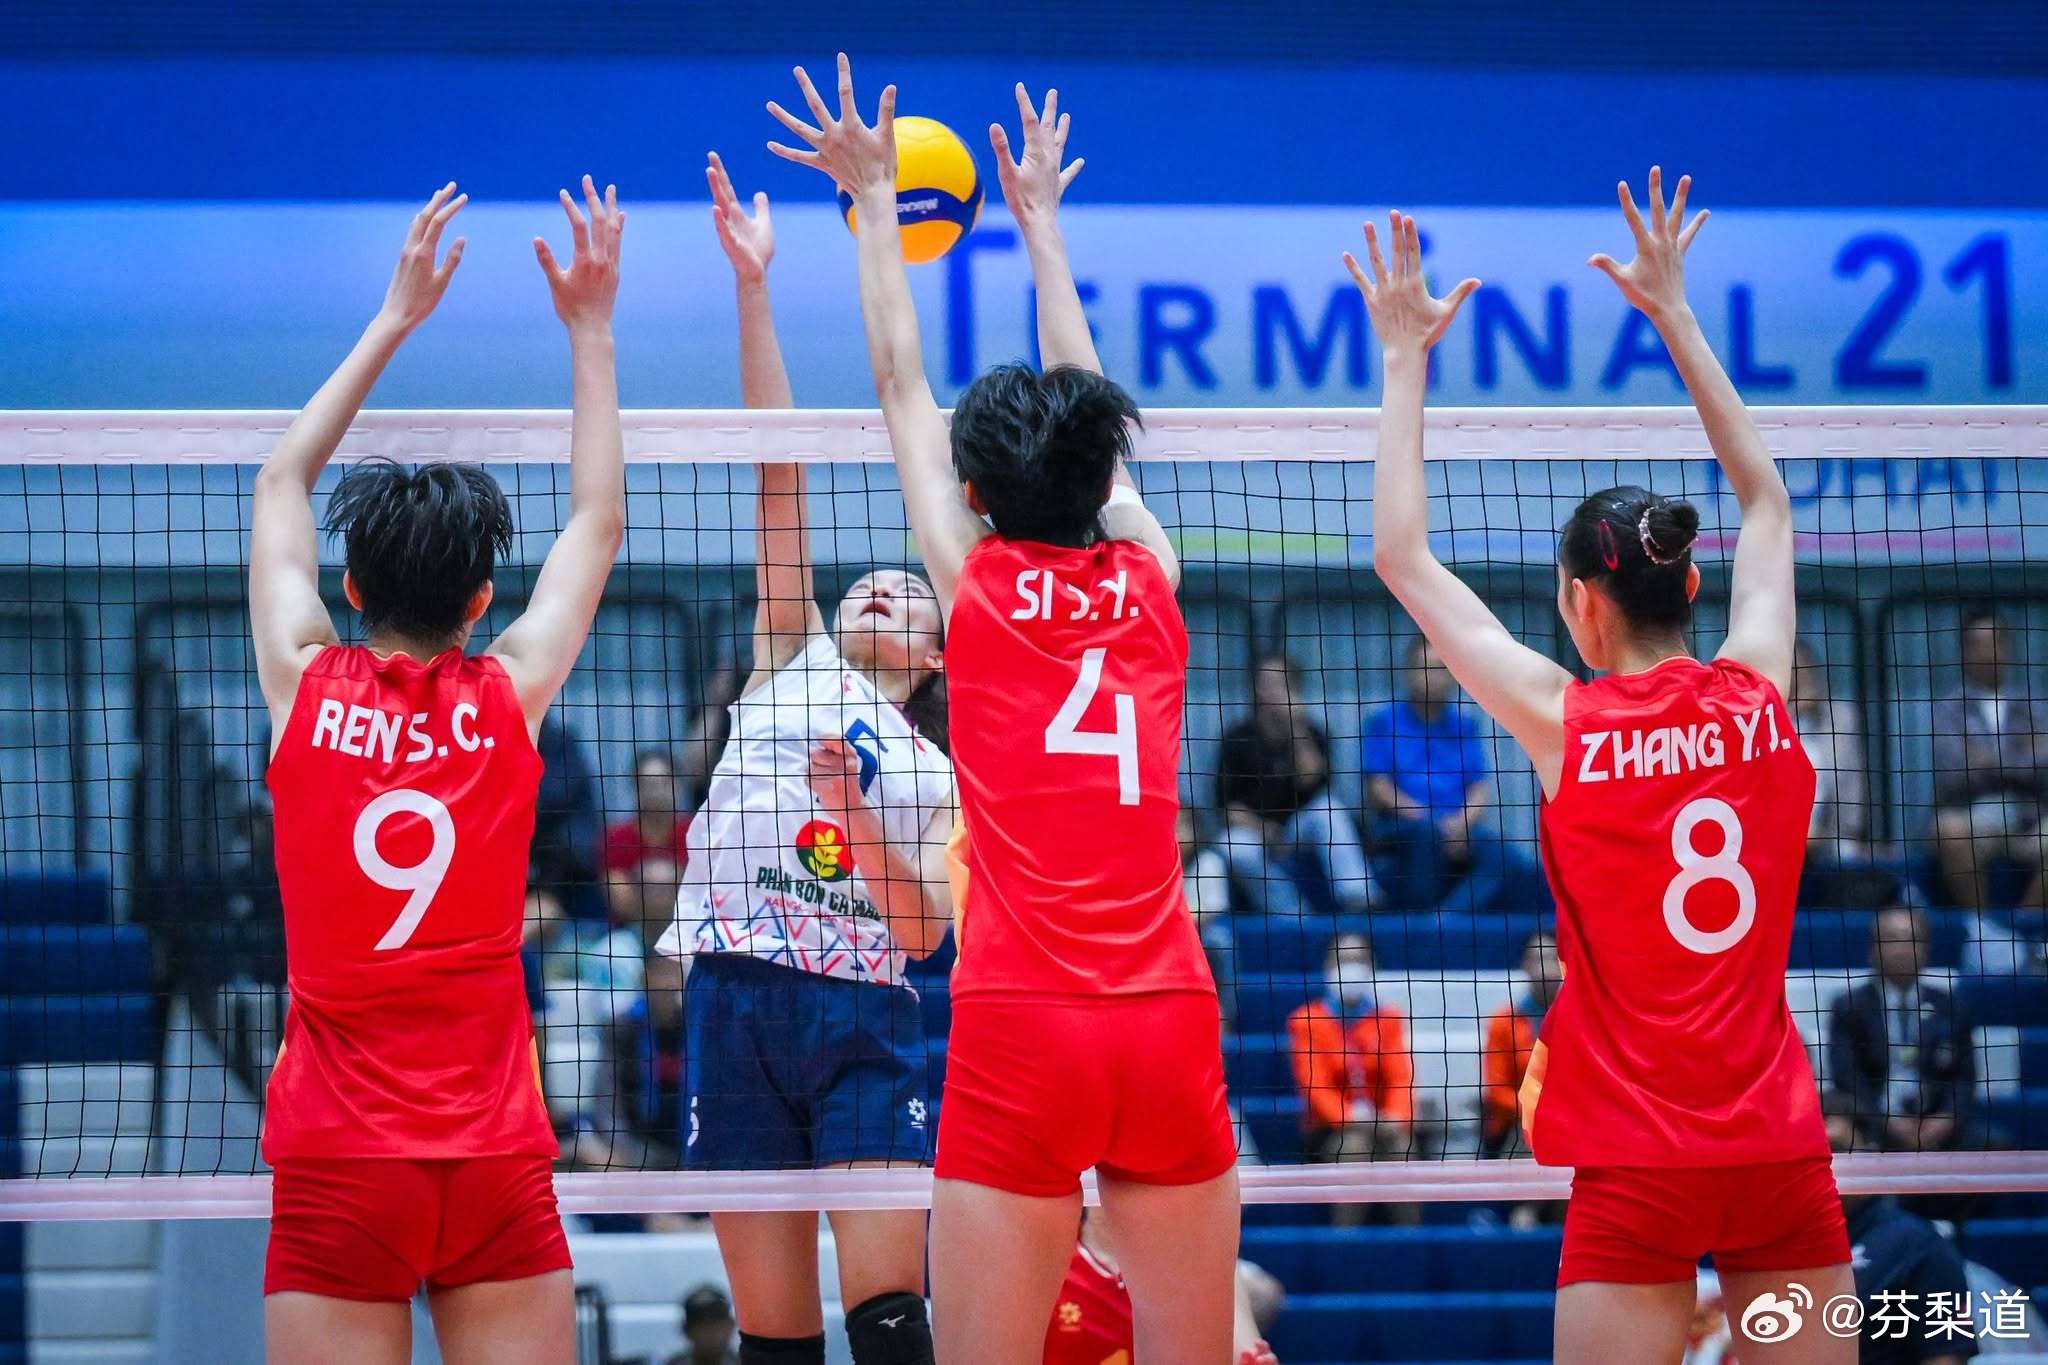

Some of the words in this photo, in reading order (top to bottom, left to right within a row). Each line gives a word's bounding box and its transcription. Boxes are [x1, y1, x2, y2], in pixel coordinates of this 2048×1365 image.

[1832, 230, 2015, 389] 21
[1010, 570, 1053, 620] SI
[311, 698, 403, 764] REN
[1045, 647, 1140, 806] 4
[1577, 722, 1725, 783] ZHANG
[353, 788, 456, 951] 9
[1663, 797, 1757, 954] 8
